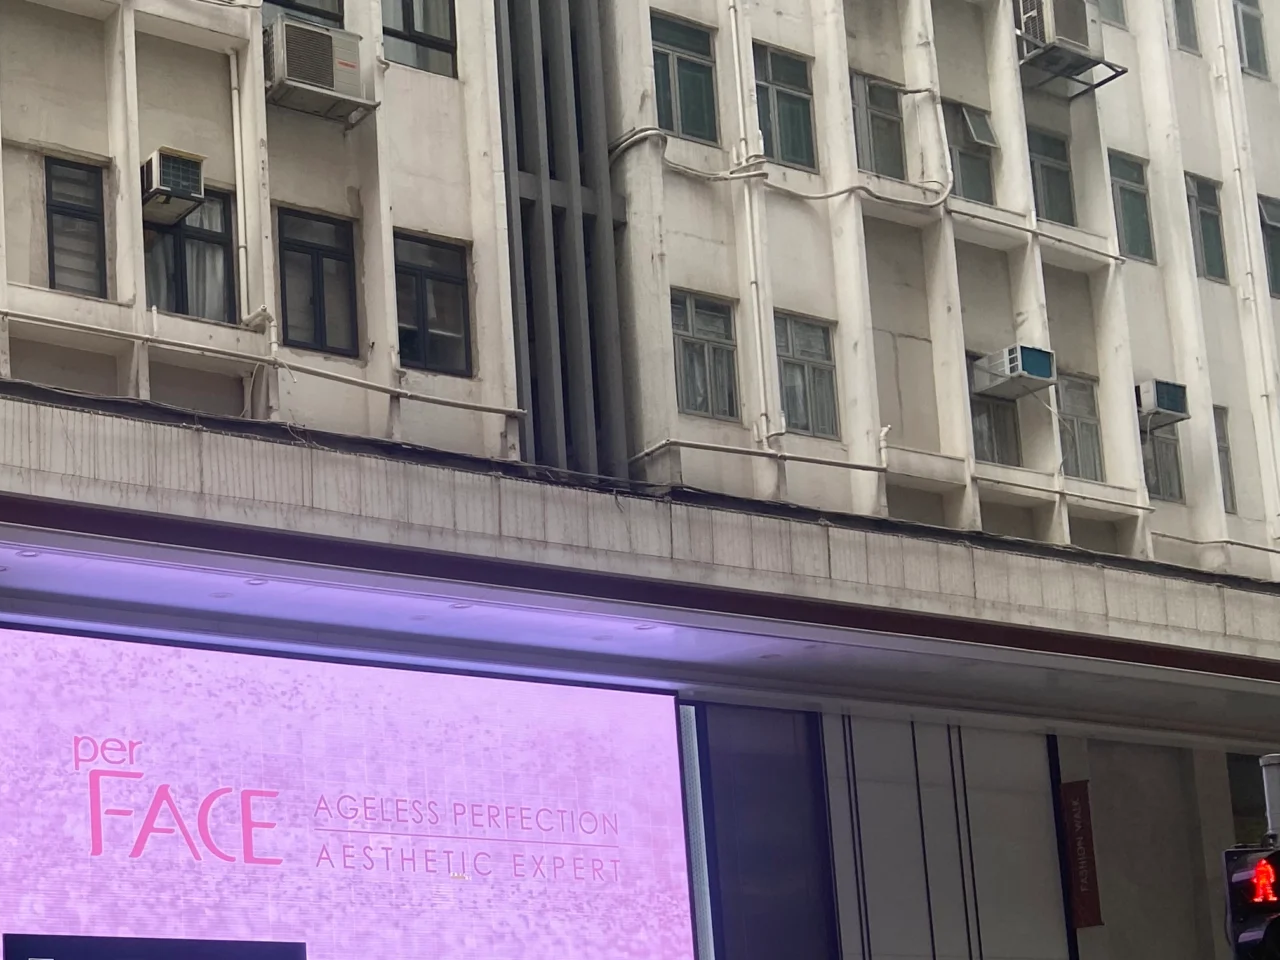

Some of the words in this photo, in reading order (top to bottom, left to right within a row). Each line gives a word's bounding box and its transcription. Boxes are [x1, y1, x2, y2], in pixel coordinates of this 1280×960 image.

[72, 734, 142, 770] per
[87, 769, 284, 866] FACE
[314, 794, 441, 826] AGELESS
[451, 800, 621, 837] PERFECTION
[315, 843, 494, 878] AESTHETIC
[512, 851, 623, 883] EXPERT
